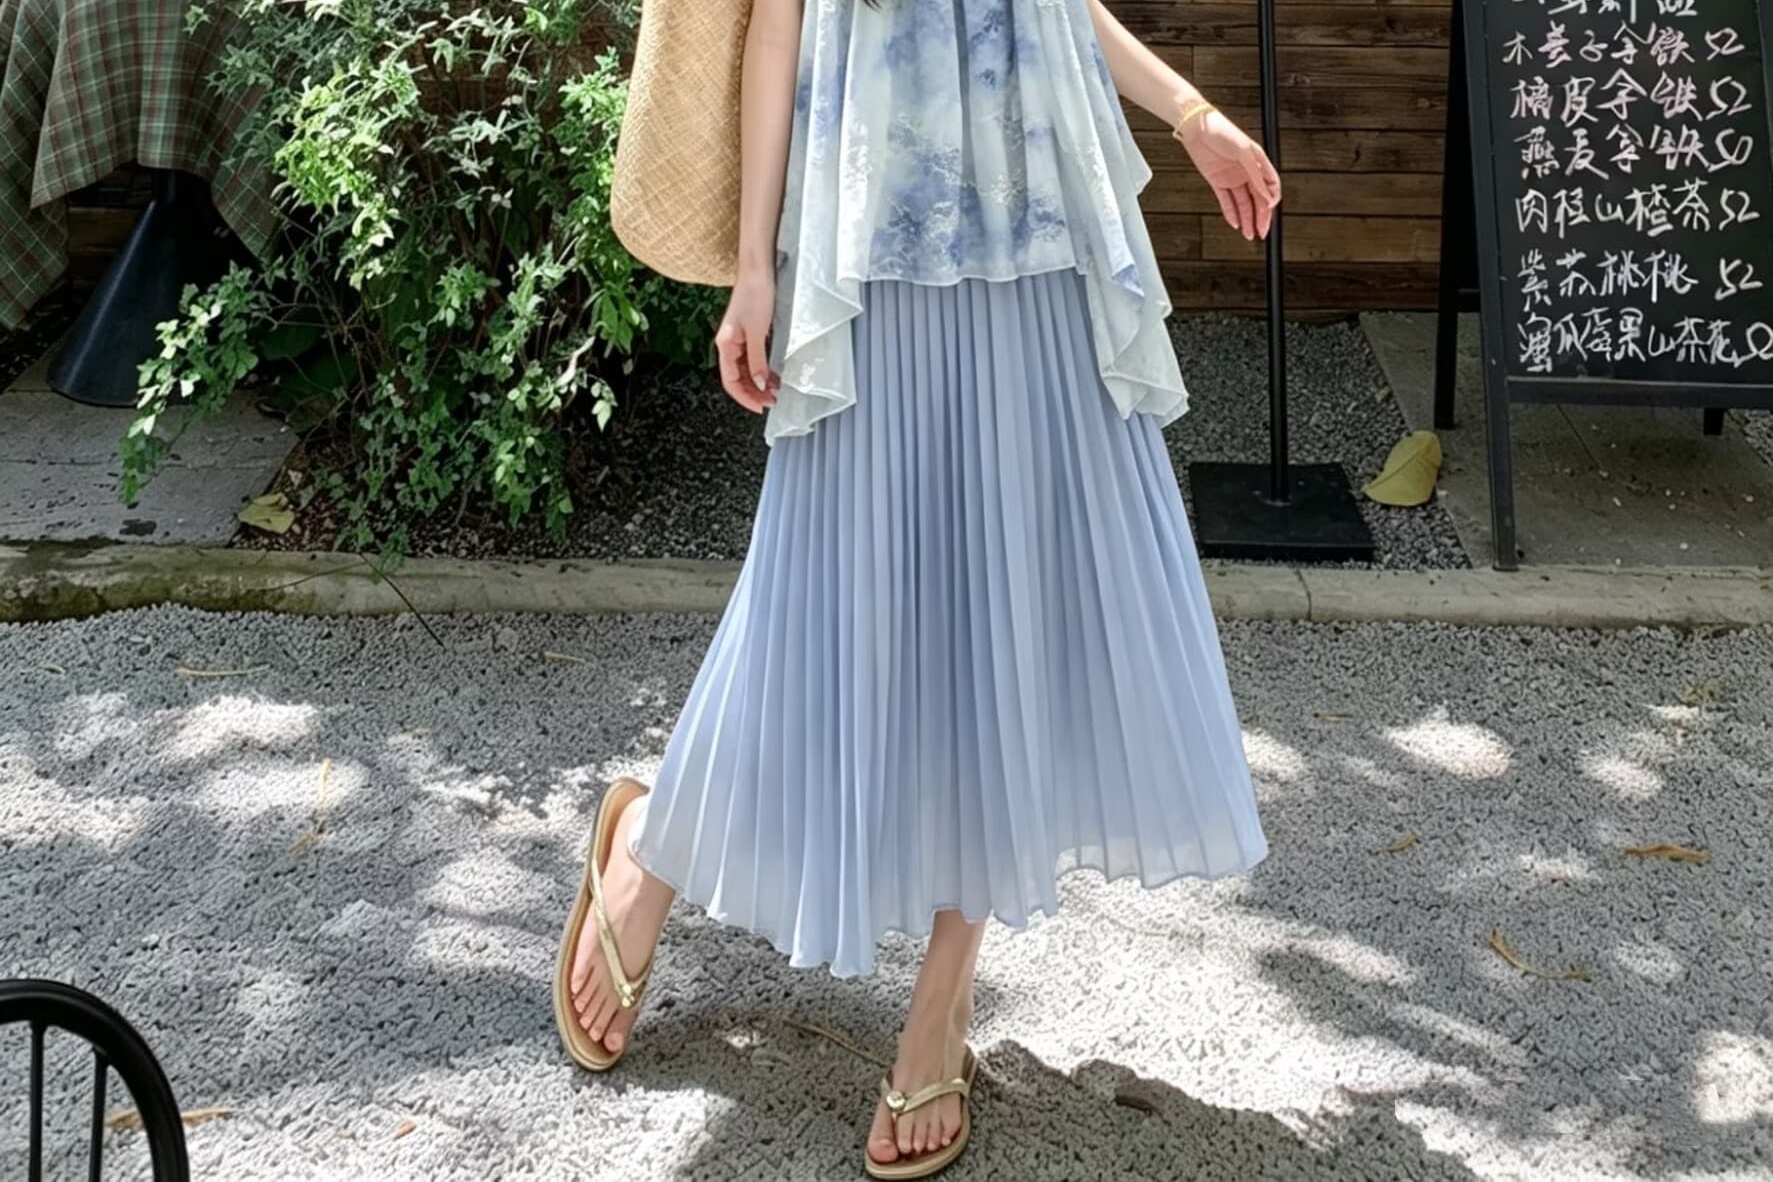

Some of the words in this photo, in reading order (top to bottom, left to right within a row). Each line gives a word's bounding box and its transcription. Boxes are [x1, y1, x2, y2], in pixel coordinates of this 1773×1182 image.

[1704, 27, 1746, 61] 52
[1705, 75, 1753, 120] 52
[1513, 124, 1710, 180] 燕麦拿铁
[1515, 177, 1711, 240] 肉桂山楂茶
[1717, 187, 1761, 231] 52
[1714, 258, 1764, 301] 52
